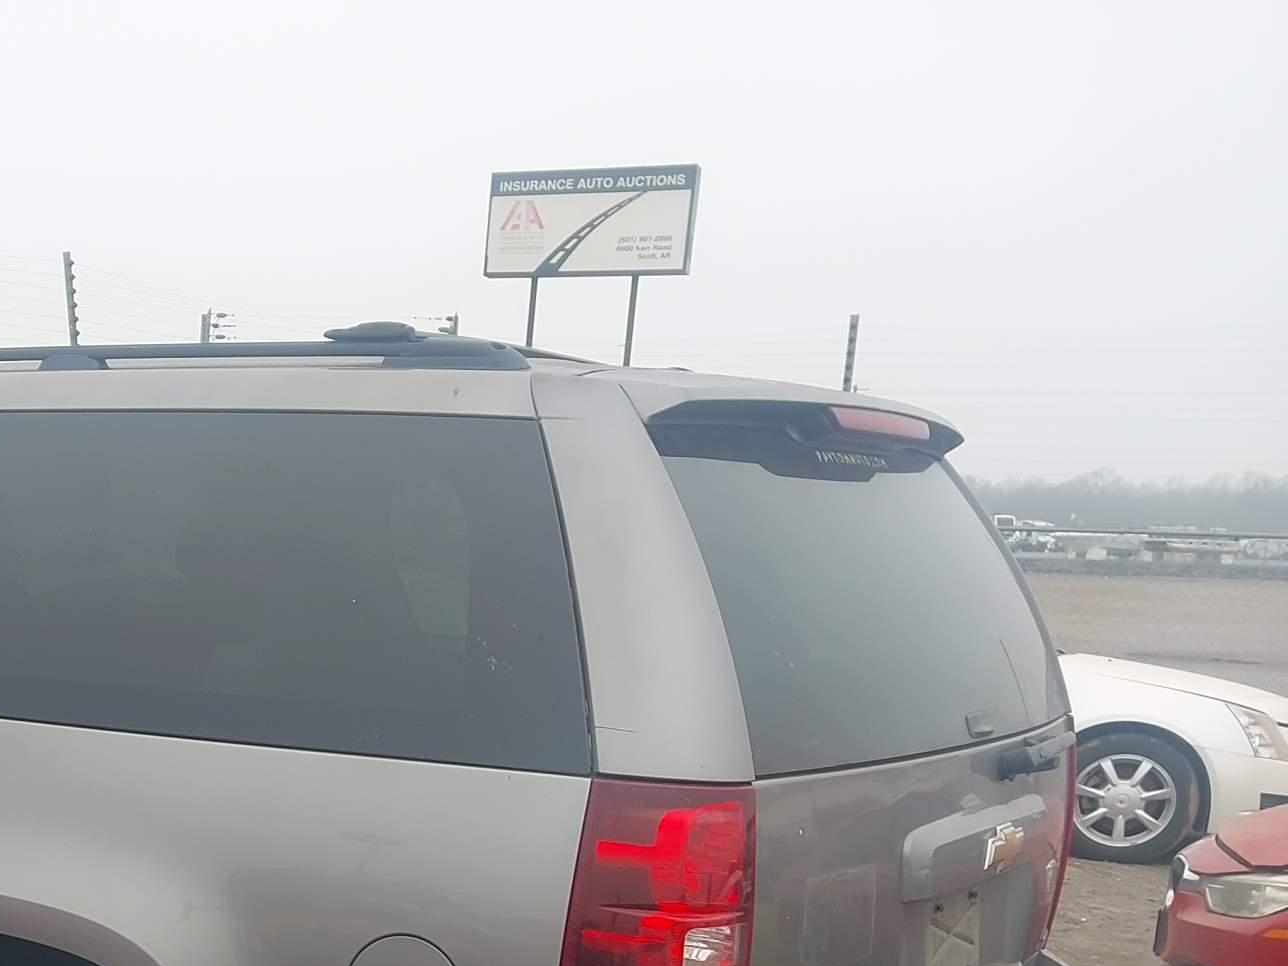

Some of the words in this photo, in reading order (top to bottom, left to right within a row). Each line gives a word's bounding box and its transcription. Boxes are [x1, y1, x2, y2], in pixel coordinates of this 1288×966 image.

[499, 178, 575, 192] INSURANCE
[577, 177, 614, 189] AUTO
[616, 173, 687, 188] AUCTIONS
